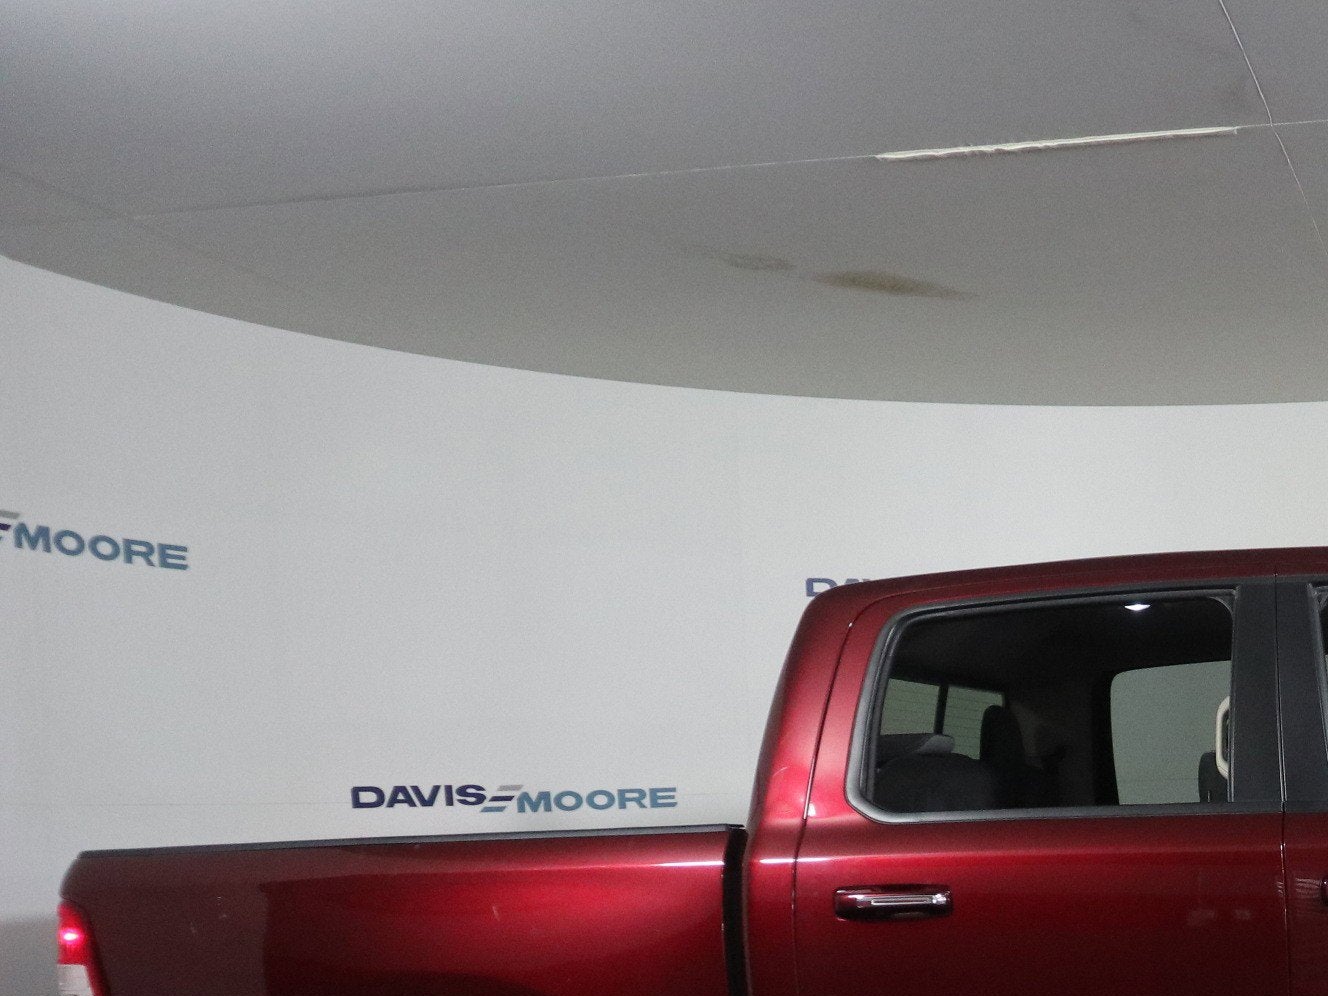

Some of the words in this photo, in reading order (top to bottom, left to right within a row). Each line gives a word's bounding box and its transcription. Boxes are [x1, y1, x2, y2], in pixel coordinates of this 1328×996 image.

[13, 522, 189, 570] MOORE
[350, 785, 488, 809] DAVIS
[517, 787, 678, 813] MOORE
